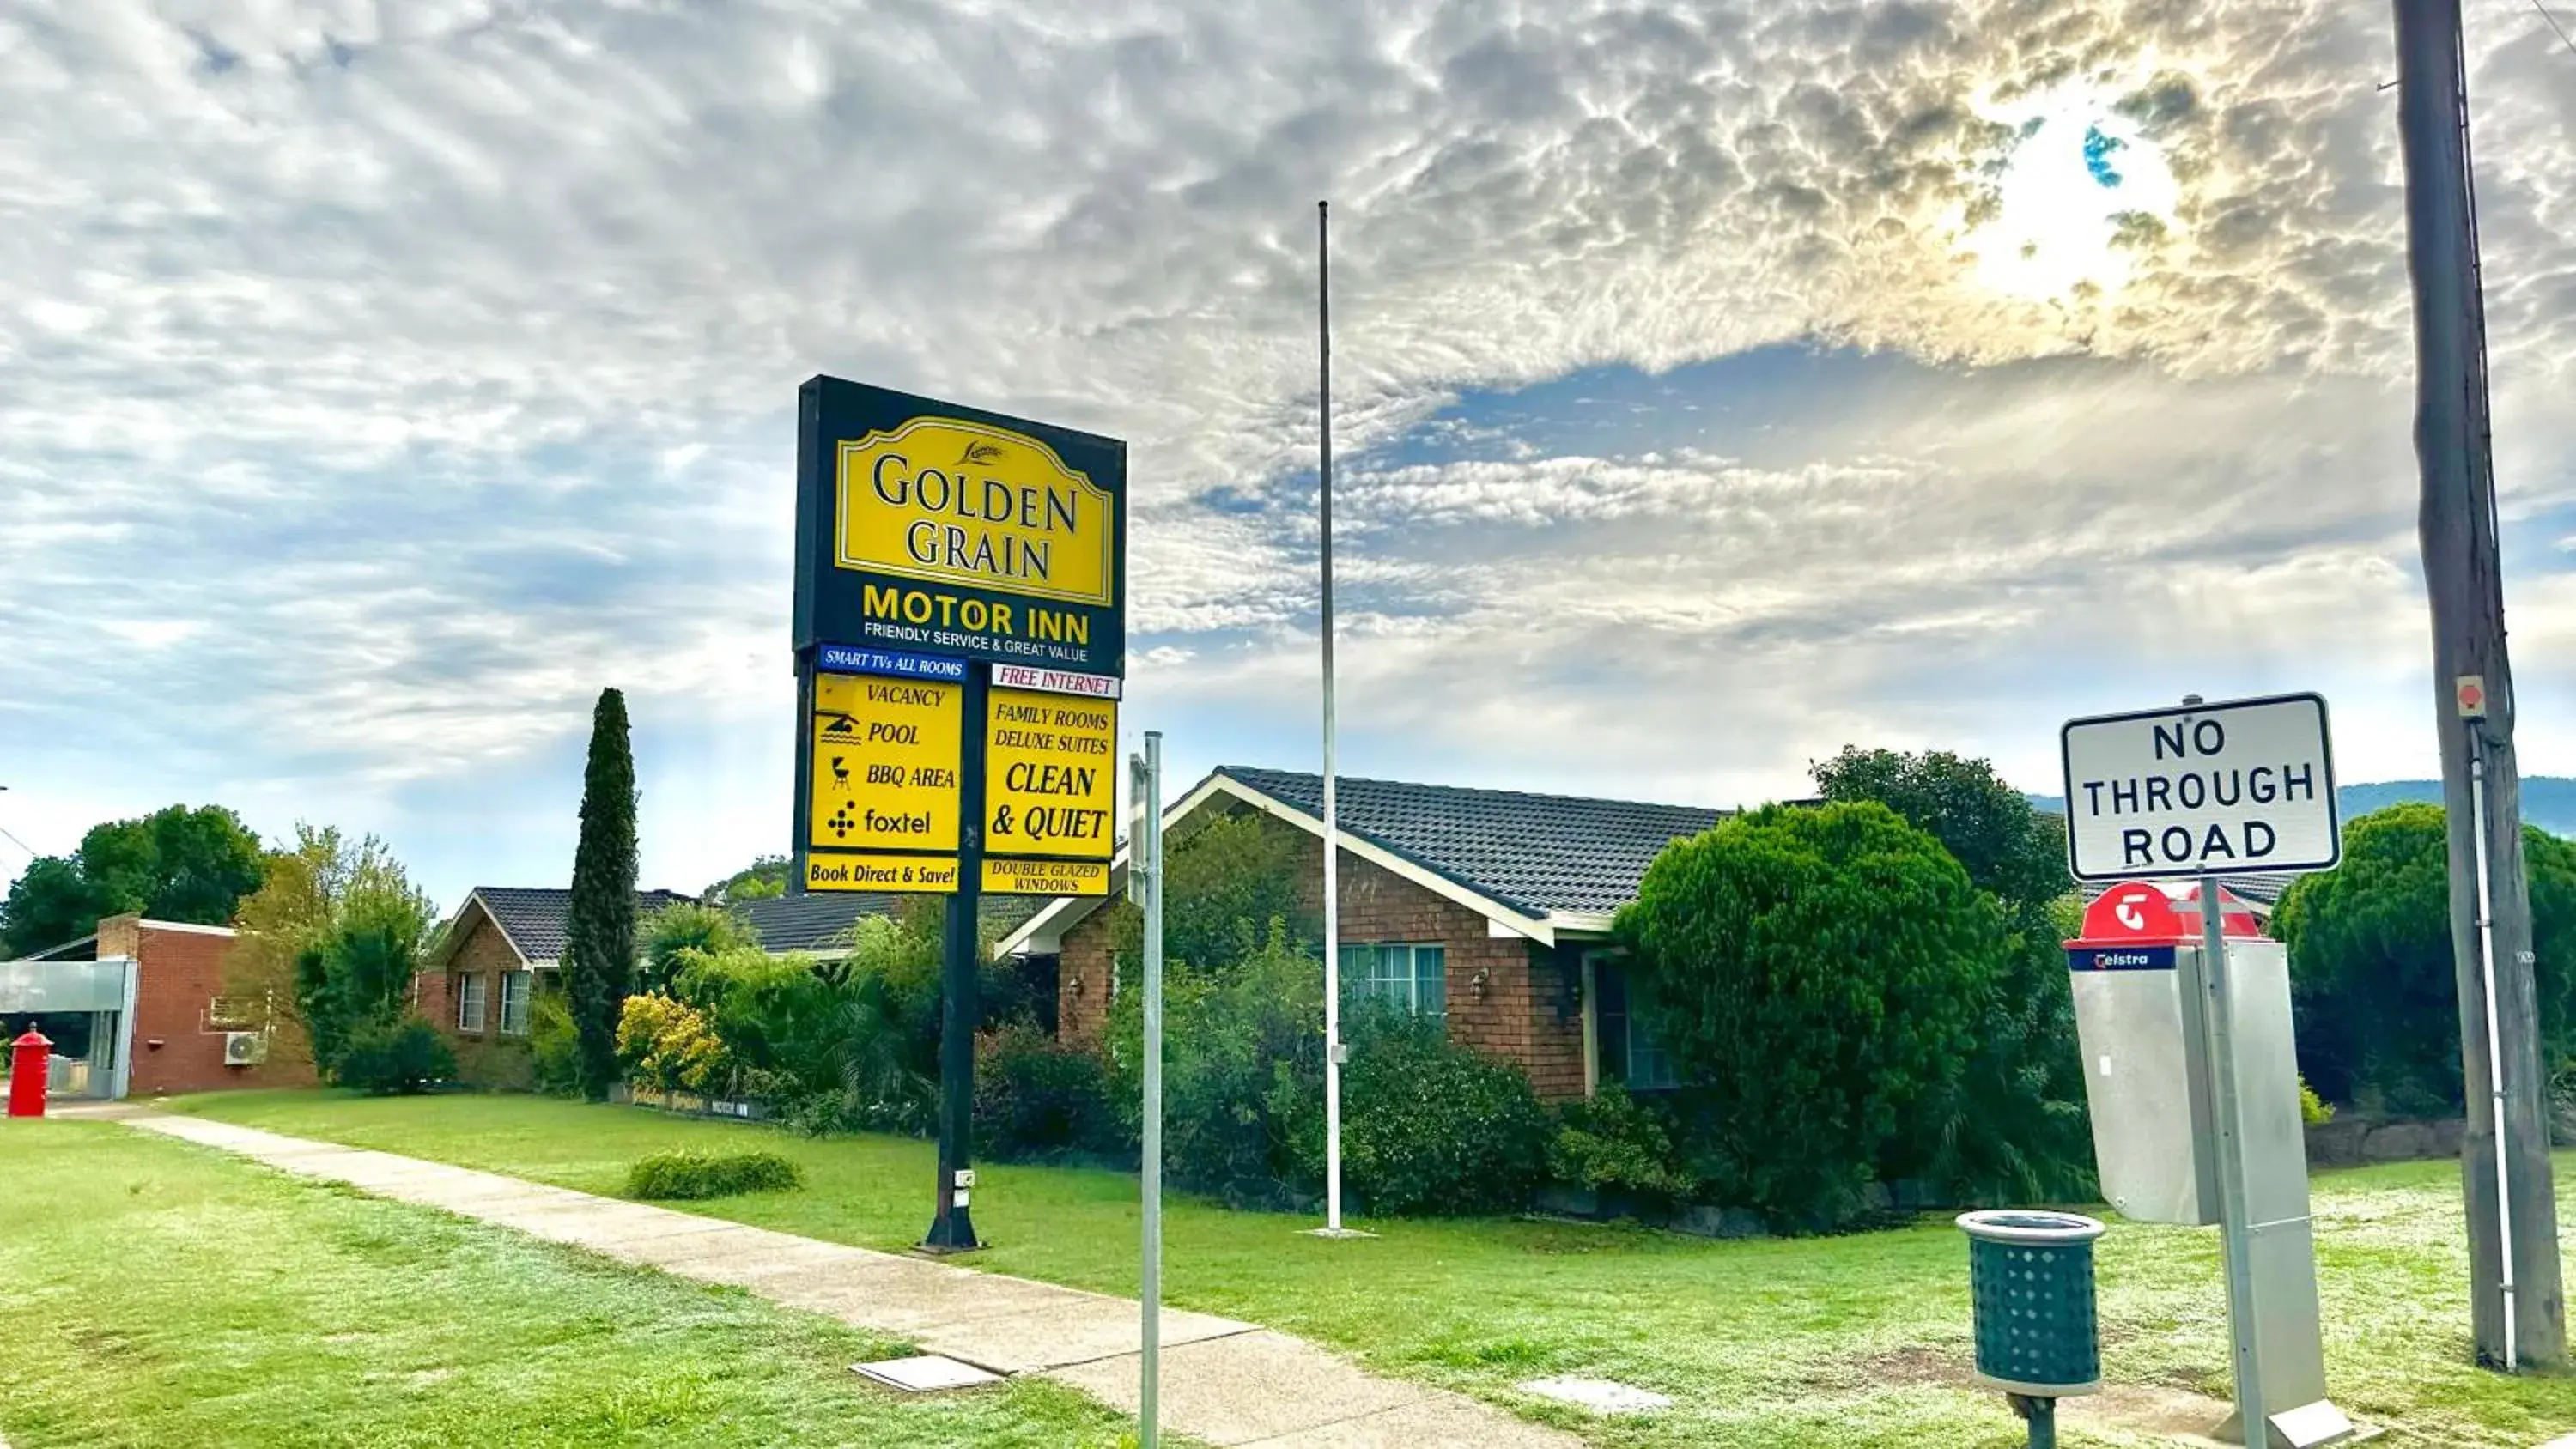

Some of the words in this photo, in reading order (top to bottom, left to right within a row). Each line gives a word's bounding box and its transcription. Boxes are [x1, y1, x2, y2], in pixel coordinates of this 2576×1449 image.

[872, 453, 1078, 535] GOLDEN
[907, 520, 1050, 581] GRAIN
[864, 584, 1014, 635] MOTOR
[1028, 608, 1089, 645] INN
[865, 622, 929, 642] FRIENDLY
[933, 631, 988, 651] SERVICE
[993, 641, 1001, 652] &
[1005, 640, 1046, 658] GREAT
[1048, 646, 1088, 662] VALUE
[825, 650, 870, 665] SMART
[872, 655, 892, 669] TVs
[894, 658, 916, 672] ALL
[919, 660, 963, 676] ROOMS
[999, 667, 1040, 686] FREE
[1042, 671, 1114, 694] INTERNET
[867, 684, 946, 707] VACANCY
[995, 703, 1052, 724] FAMILY
[1054, 710, 1109, 731] ROOMS
[868, 722, 920, 745] POOL
[994, 729, 1055, 750] DELUXE
[1057, 734, 1109, 755] SUITES
[2152, 719, 2226, 761] NO
[866, 764, 906, 788] BBQ
[908, 767, 956, 789] AREA
[1005, 762, 1097, 797] CLEAN
[2082, 762, 2314, 816] THROUGH
[865, 808, 931, 834] foxtel
[992, 803, 1015, 834] &
[1024, 806, 1109, 841] QUIET
[2123, 821, 2276, 864] ROAD
[811, 864, 848, 882] Book
[854, 864, 898, 883] Direct
[902, 866, 914, 883] &
[918, 866, 957, 883] Save!
[992, 861, 1047, 876] DOUBLE
[1050, 864, 1101, 878] GLAZED
[1014, 877, 1079, 892] WINDOWS
[2093, 954, 2148, 969] Telstra
